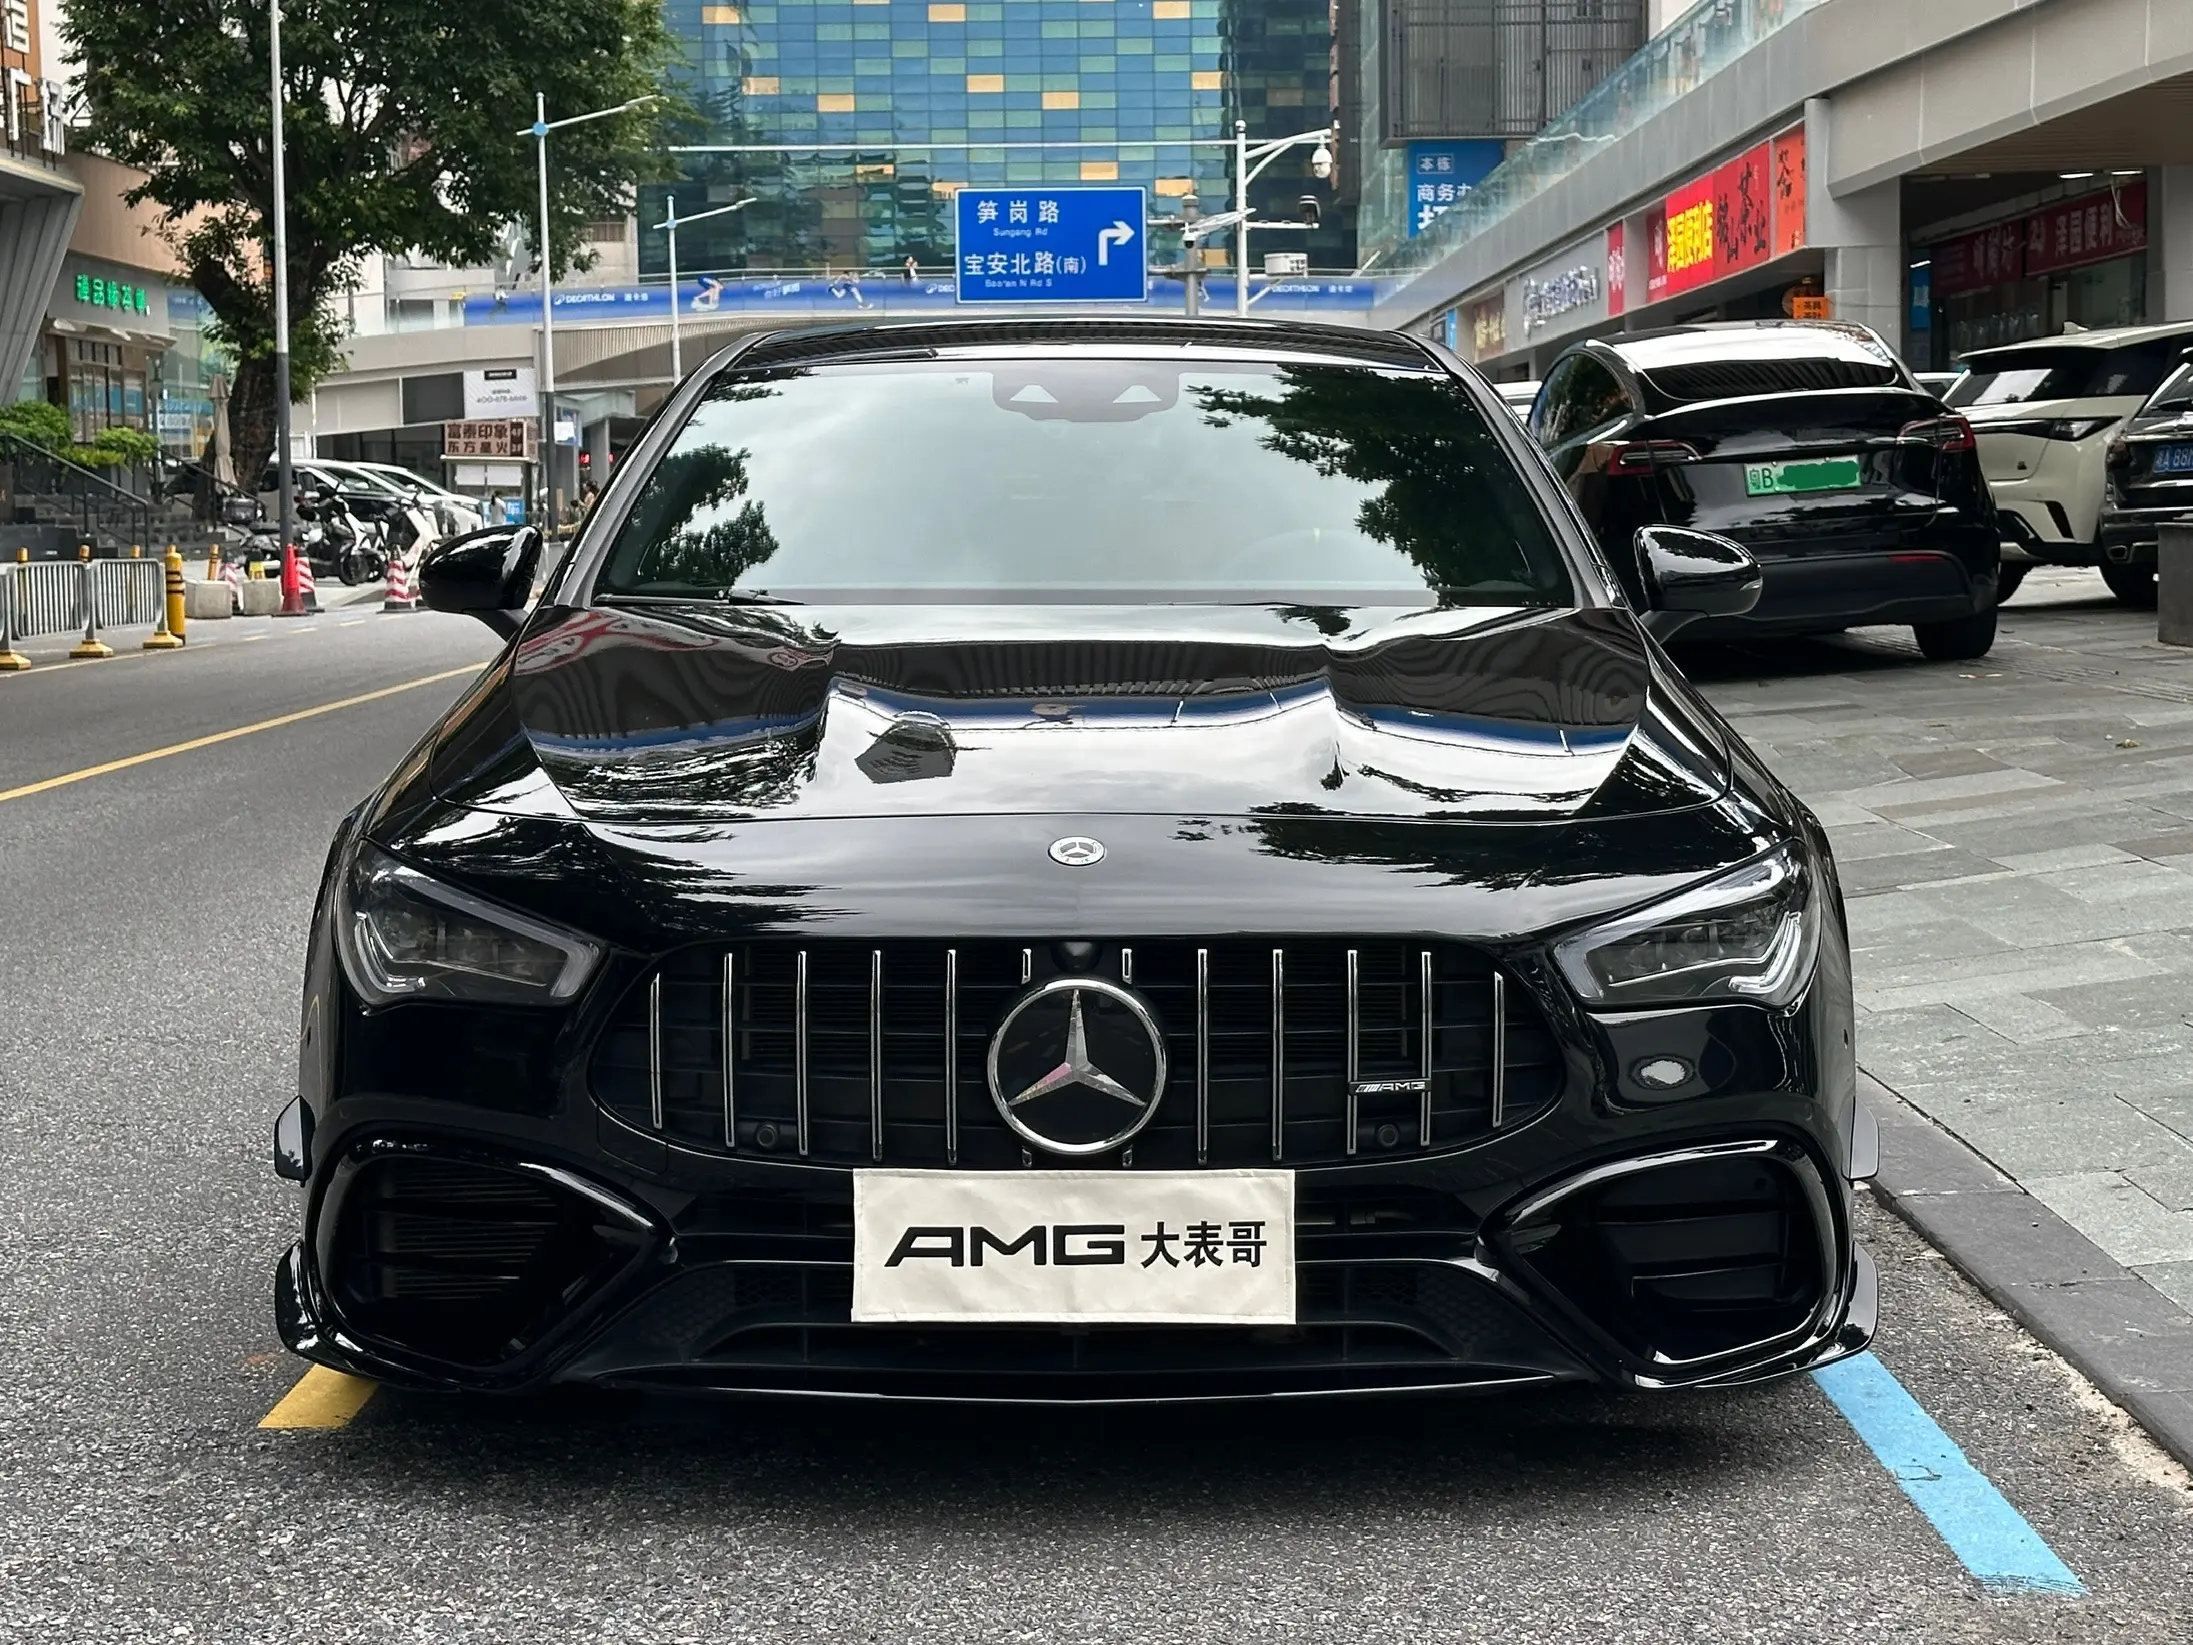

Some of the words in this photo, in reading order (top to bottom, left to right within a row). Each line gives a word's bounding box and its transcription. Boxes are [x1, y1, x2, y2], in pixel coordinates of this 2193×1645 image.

[977, 200, 1060, 224] 笋岗路
[993, 227, 1032, 238] Sungang
[1035, 227, 1048, 236] Rd
[1030, 279, 1042, 287] Rd
[1045, 279, 1053, 287] S
[1378, 1081, 1426, 1093] AMG
[884, 1224, 1126, 1268] AMG
[1140, 1220, 1267, 1269] 大表哥
